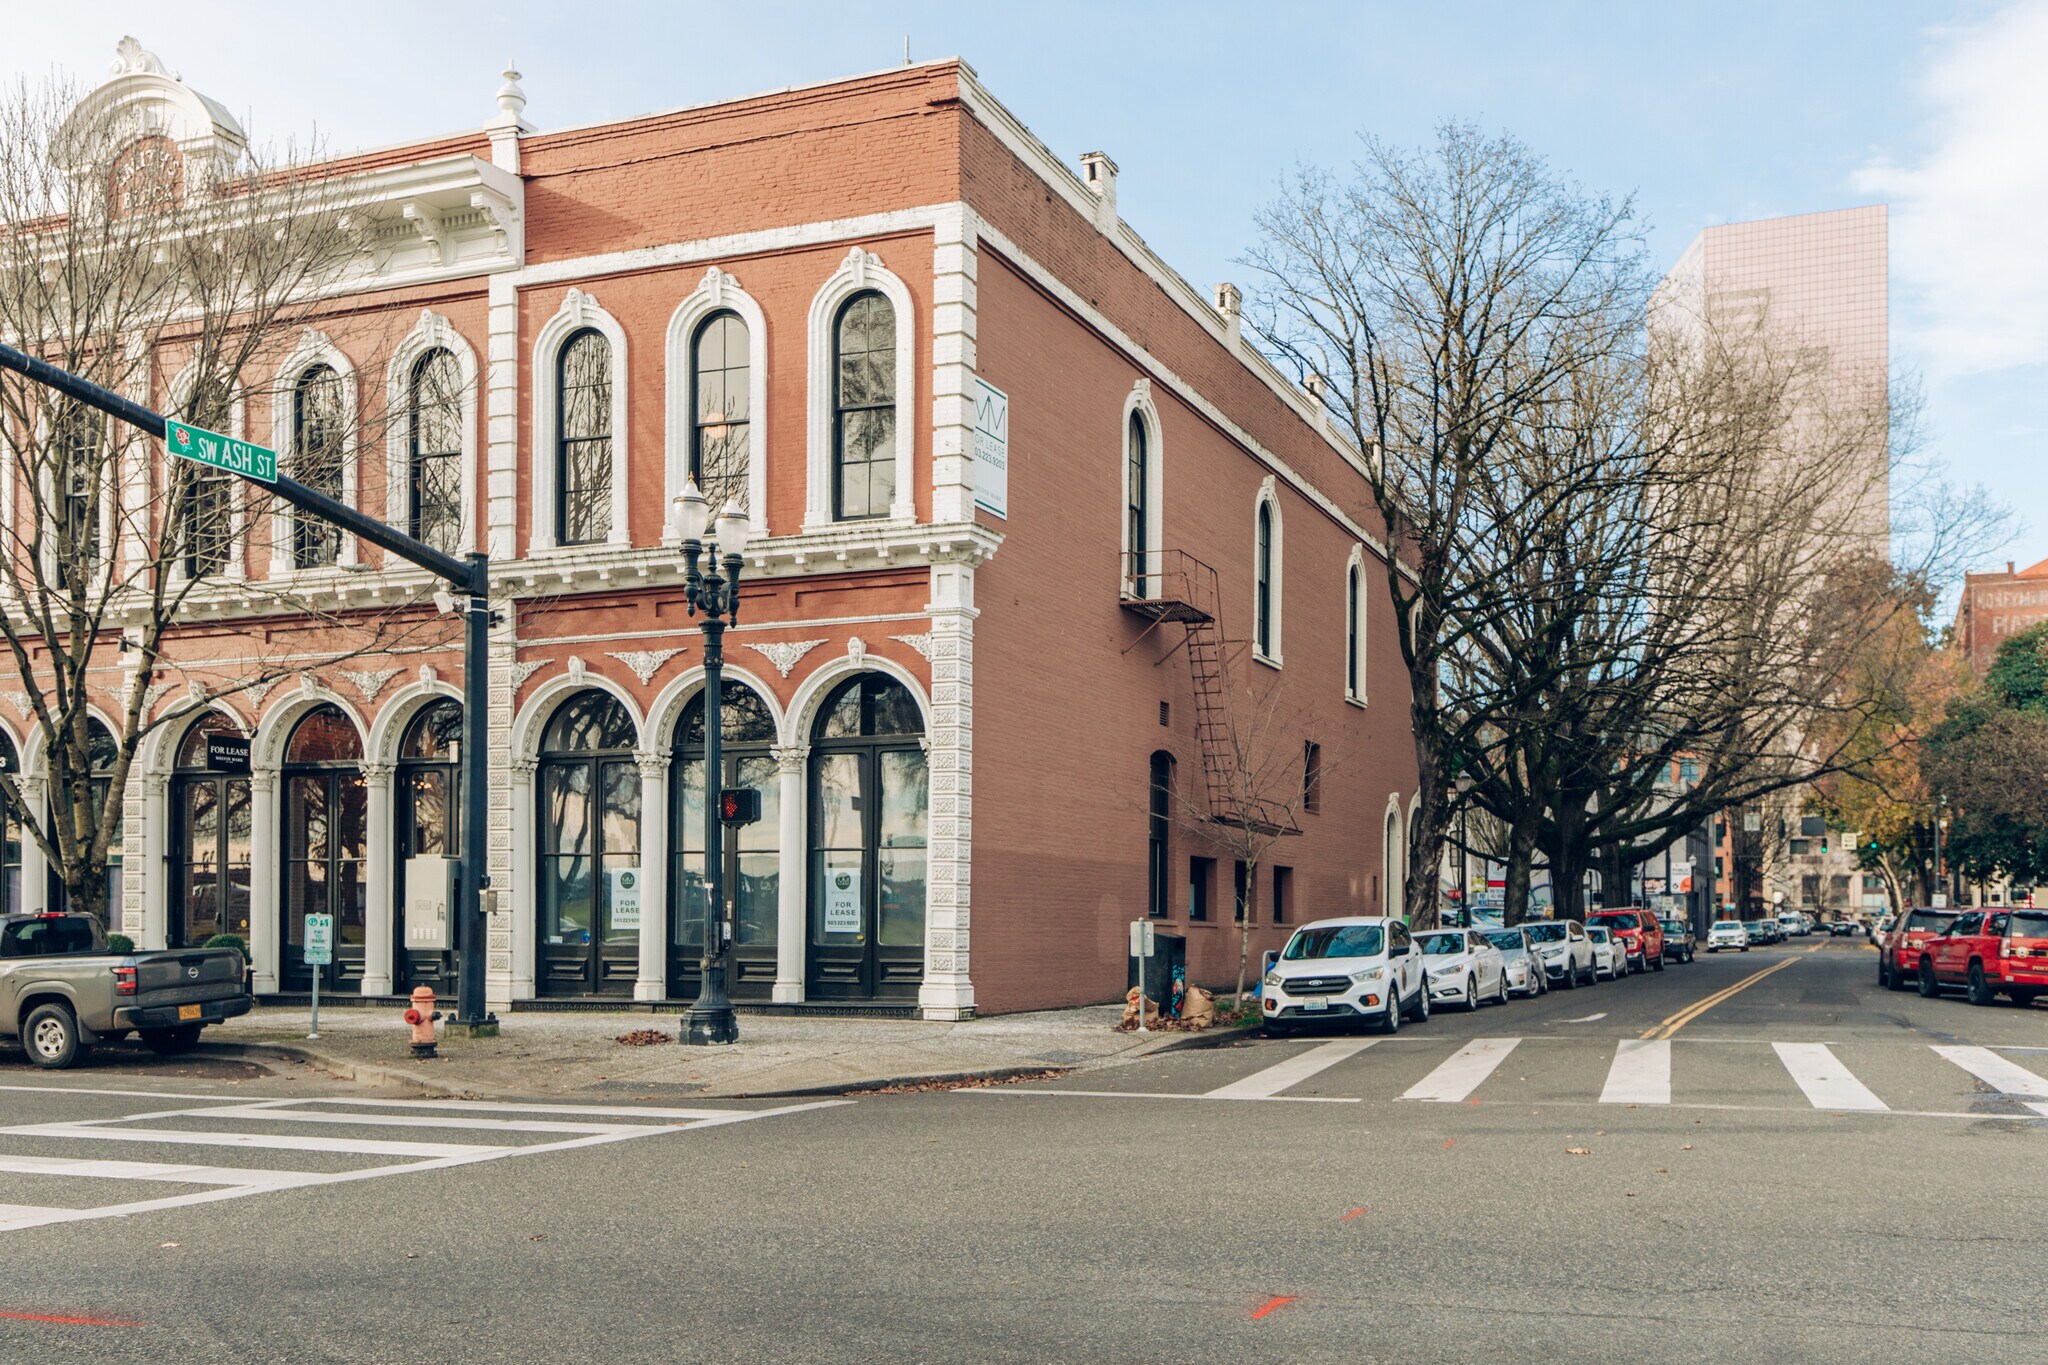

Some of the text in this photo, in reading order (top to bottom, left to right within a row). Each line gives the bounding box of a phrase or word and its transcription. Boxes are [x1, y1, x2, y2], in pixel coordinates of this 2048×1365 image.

[198, 437, 272, 477] SW ASH ST
[975, 433, 1005, 458] OR LEASE
[210, 745, 249, 757] FOR LEASE
